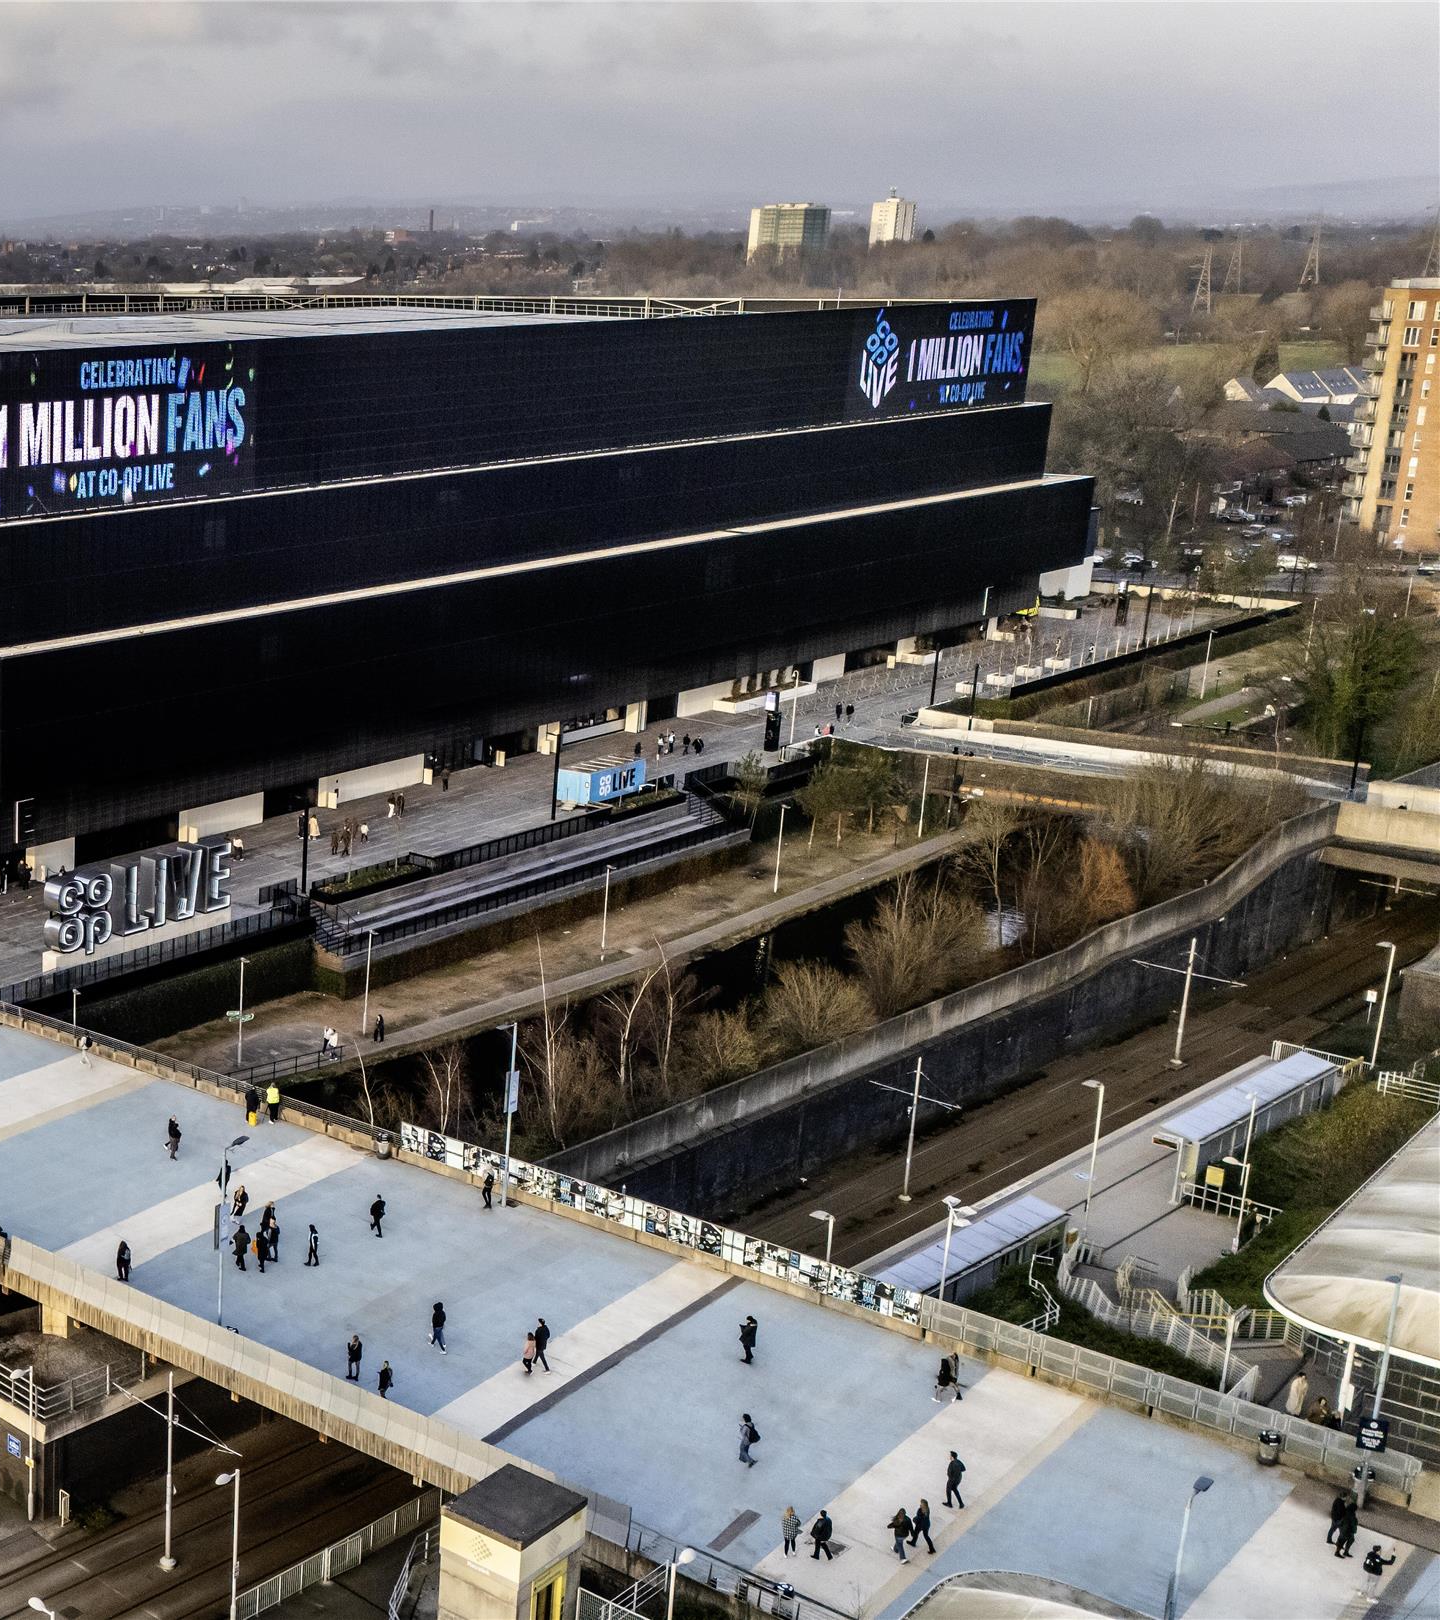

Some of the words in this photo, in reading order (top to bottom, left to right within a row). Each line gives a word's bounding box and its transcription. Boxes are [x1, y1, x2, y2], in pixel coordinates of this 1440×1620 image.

[80, 357, 176, 390] CELEBRATING
[860, 347, 900, 408] LIVE
[917, 335, 984, 382] MILLION
[984, 332, 1024, 374] FANS
[19, 394, 159, 466] MILLION
[166, 387, 245, 454] FANS
[77, 476, 96, 499] AT
[99, 470, 142, 496] CO-OP
[144, 463, 174, 491] LIVE
[612, 768, 636, 792] LIVE
[15, 797, 35, 844] E
[114, 842, 232, 937] LIVE
